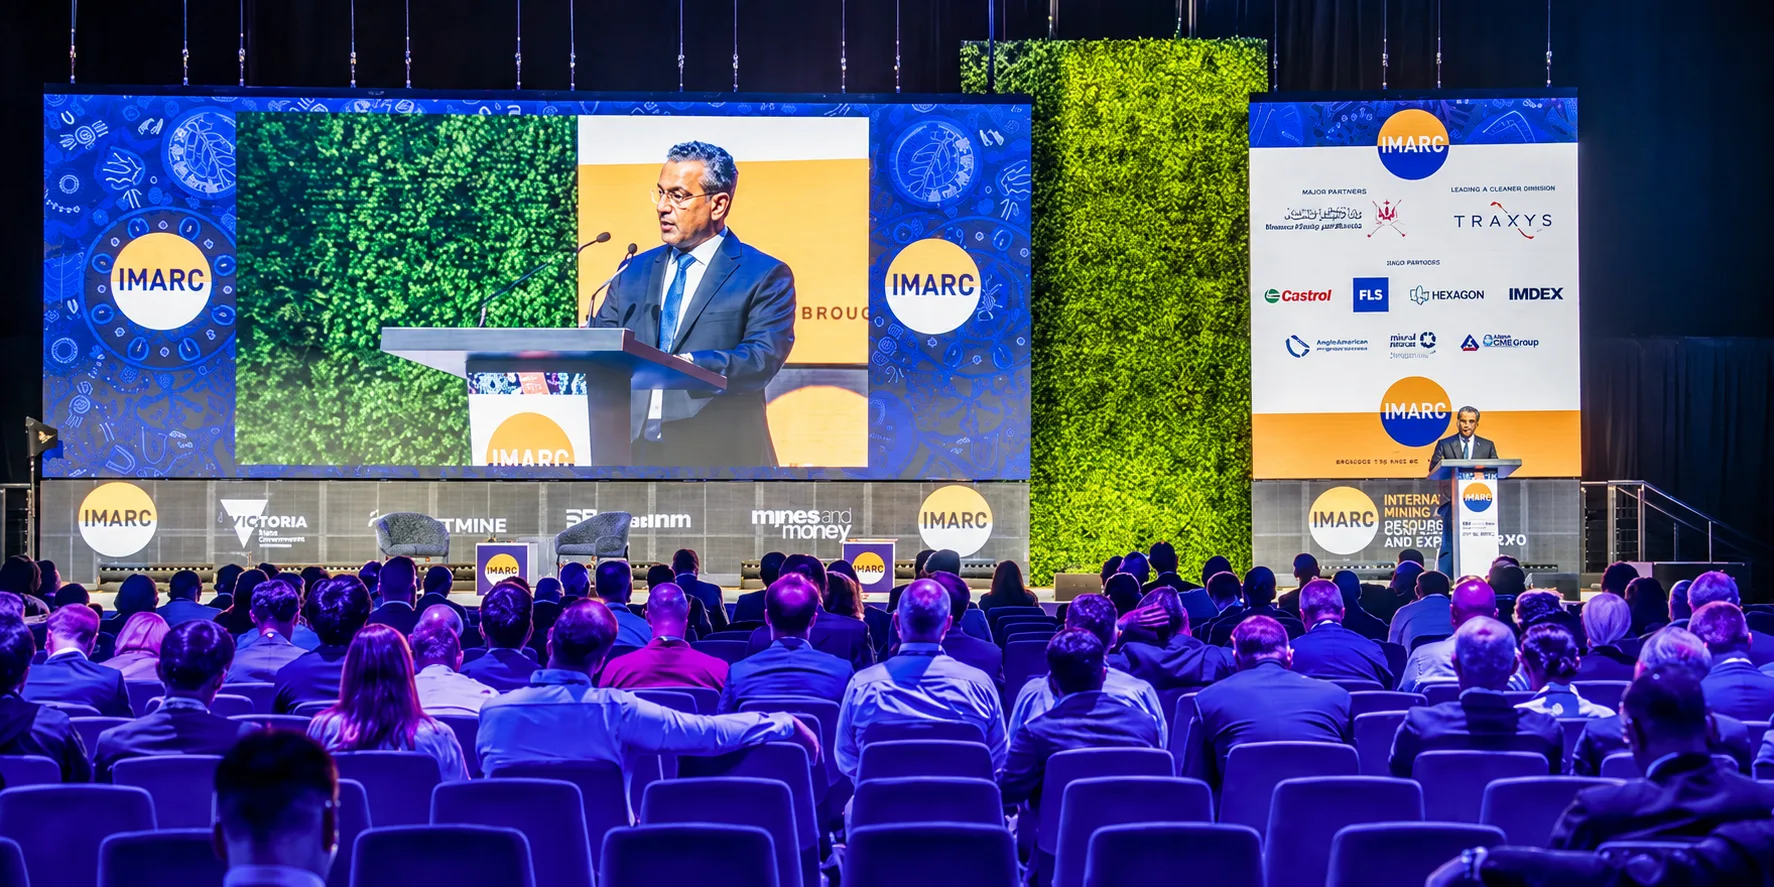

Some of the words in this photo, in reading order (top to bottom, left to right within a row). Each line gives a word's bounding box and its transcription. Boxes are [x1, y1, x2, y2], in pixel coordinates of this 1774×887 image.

[1382, 135, 1445, 153] IMARC
[1453, 214, 1552, 228] TRAXYS
[119, 268, 204, 292] IMARC
[892, 273, 975, 297] IMARC
[1281, 289, 1332, 302] Castrol
[1359, 289, 1383, 301] FLS
[1432, 290, 1485, 300] HEXAGON
[1508, 287, 1564, 301] IMDEX
[1385, 402, 1447, 420] IMARC
[1384, 494, 1441, 506] INTERNA
[84, 509, 152, 527] IMARC
[822, 507, 852, 524] and
[1313, 511, 1374, 528] IMARC
[1384, 507, 1431, 518] MINING
[232, 515, 308, 528] VICTORIA
[923, 511, 988, 529] IMARC
[782, 524, 852, 543] money
[1384, 536, 1412, 548] AND
[1416, 536, 1442, 548] EXP
[487, 566, 517, 575] IMARC
[853, 564, 884, 573] IMARC
